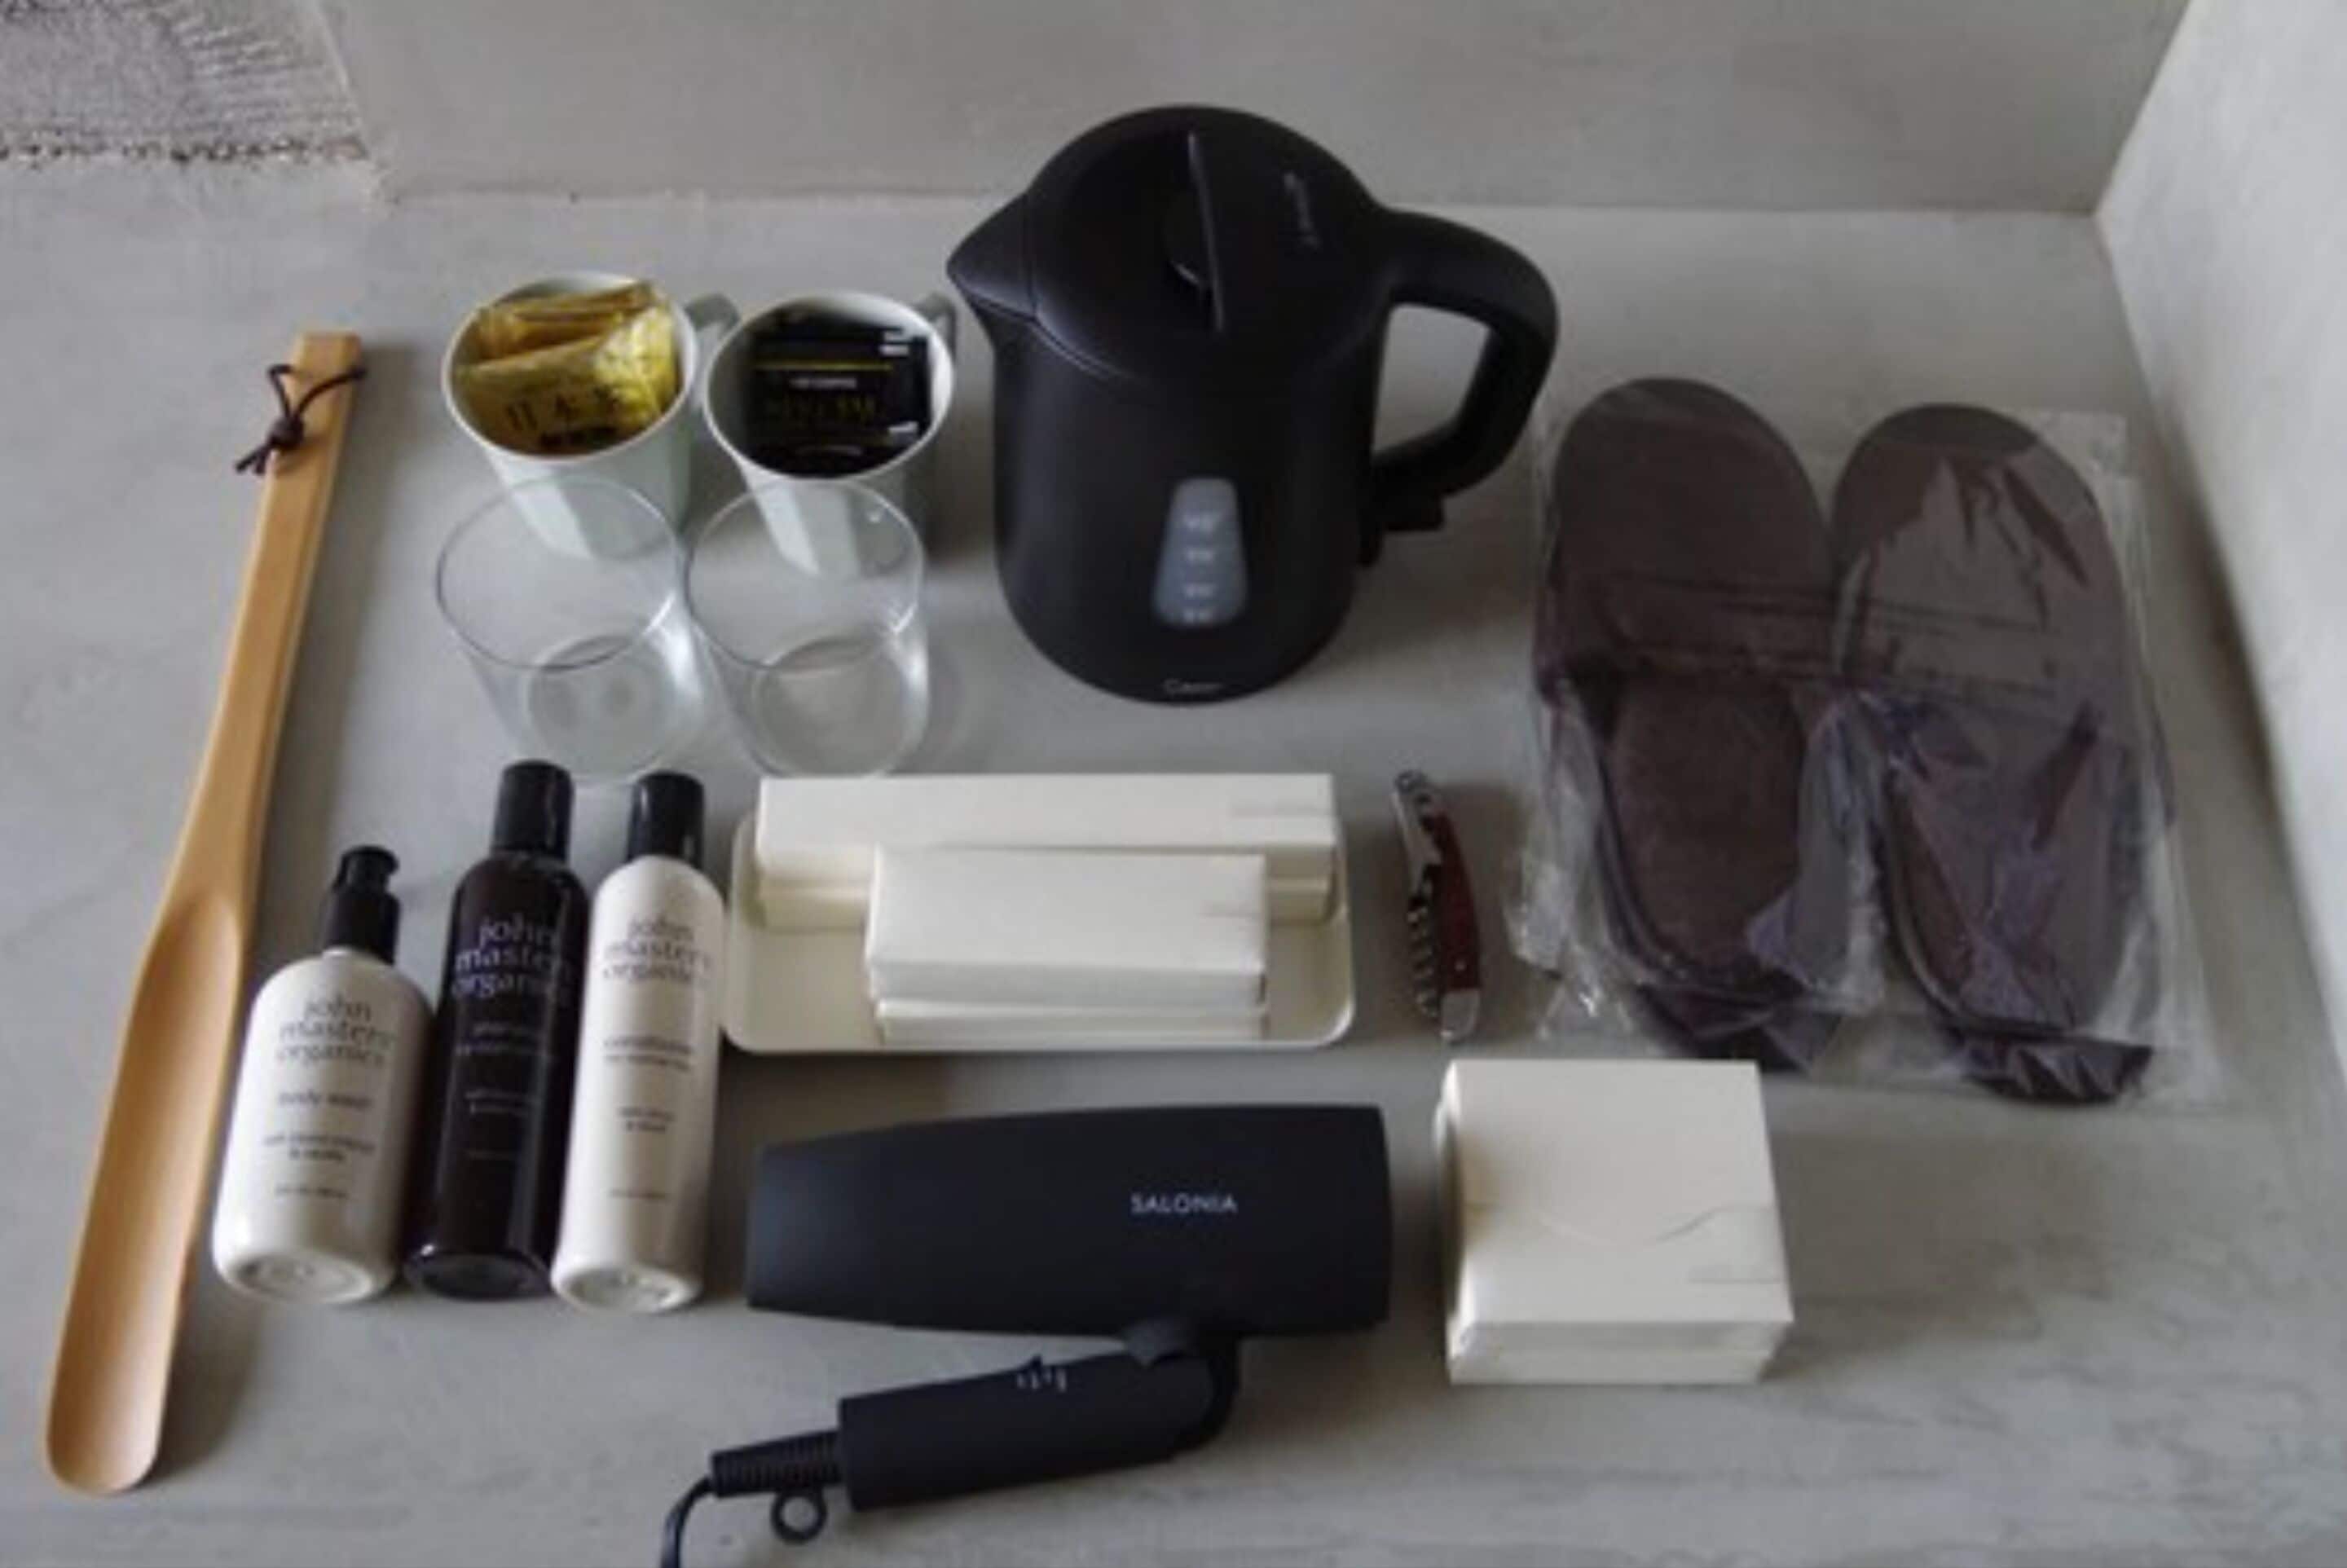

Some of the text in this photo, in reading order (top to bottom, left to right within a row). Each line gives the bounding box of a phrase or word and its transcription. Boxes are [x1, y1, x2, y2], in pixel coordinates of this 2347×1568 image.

[479, 911, 557, 949] john
[302, 993, 371, 1021] john
[1131, 1191, 1238, 1213] SALONIA
